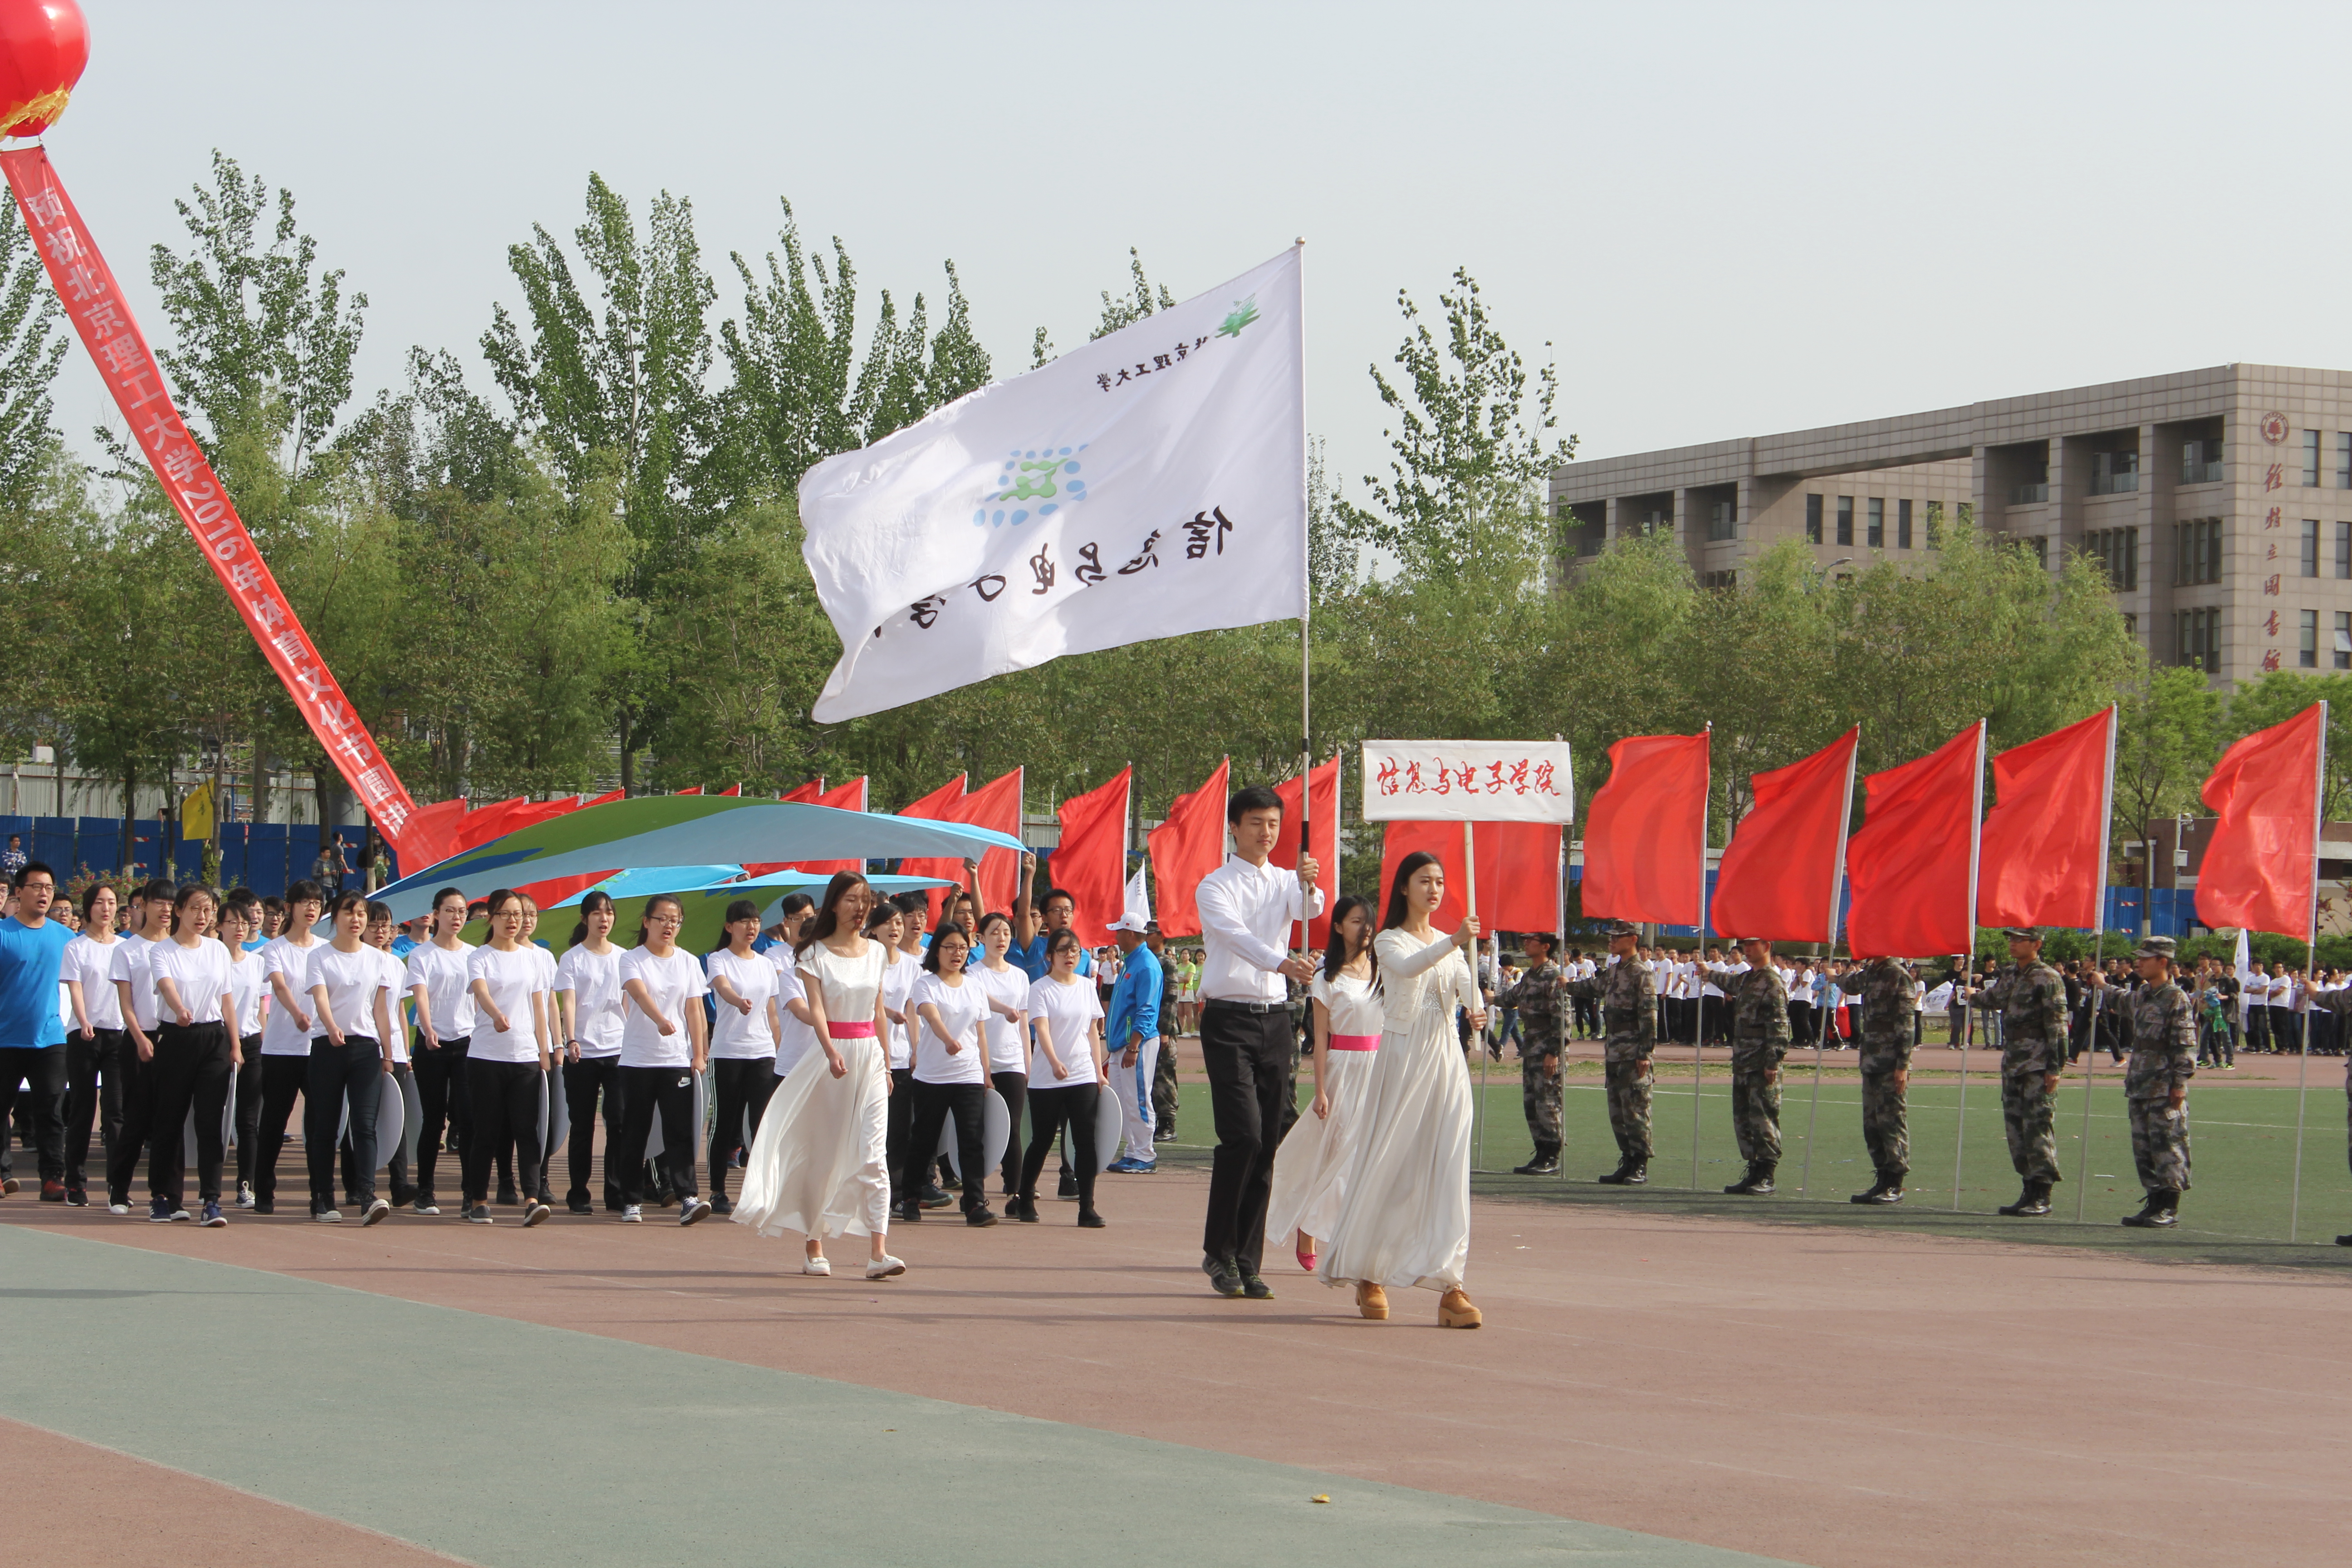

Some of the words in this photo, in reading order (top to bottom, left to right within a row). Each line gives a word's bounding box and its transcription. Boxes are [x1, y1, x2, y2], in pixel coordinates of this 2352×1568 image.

[1377, 756, 1561, 797] 信息与电子学院
